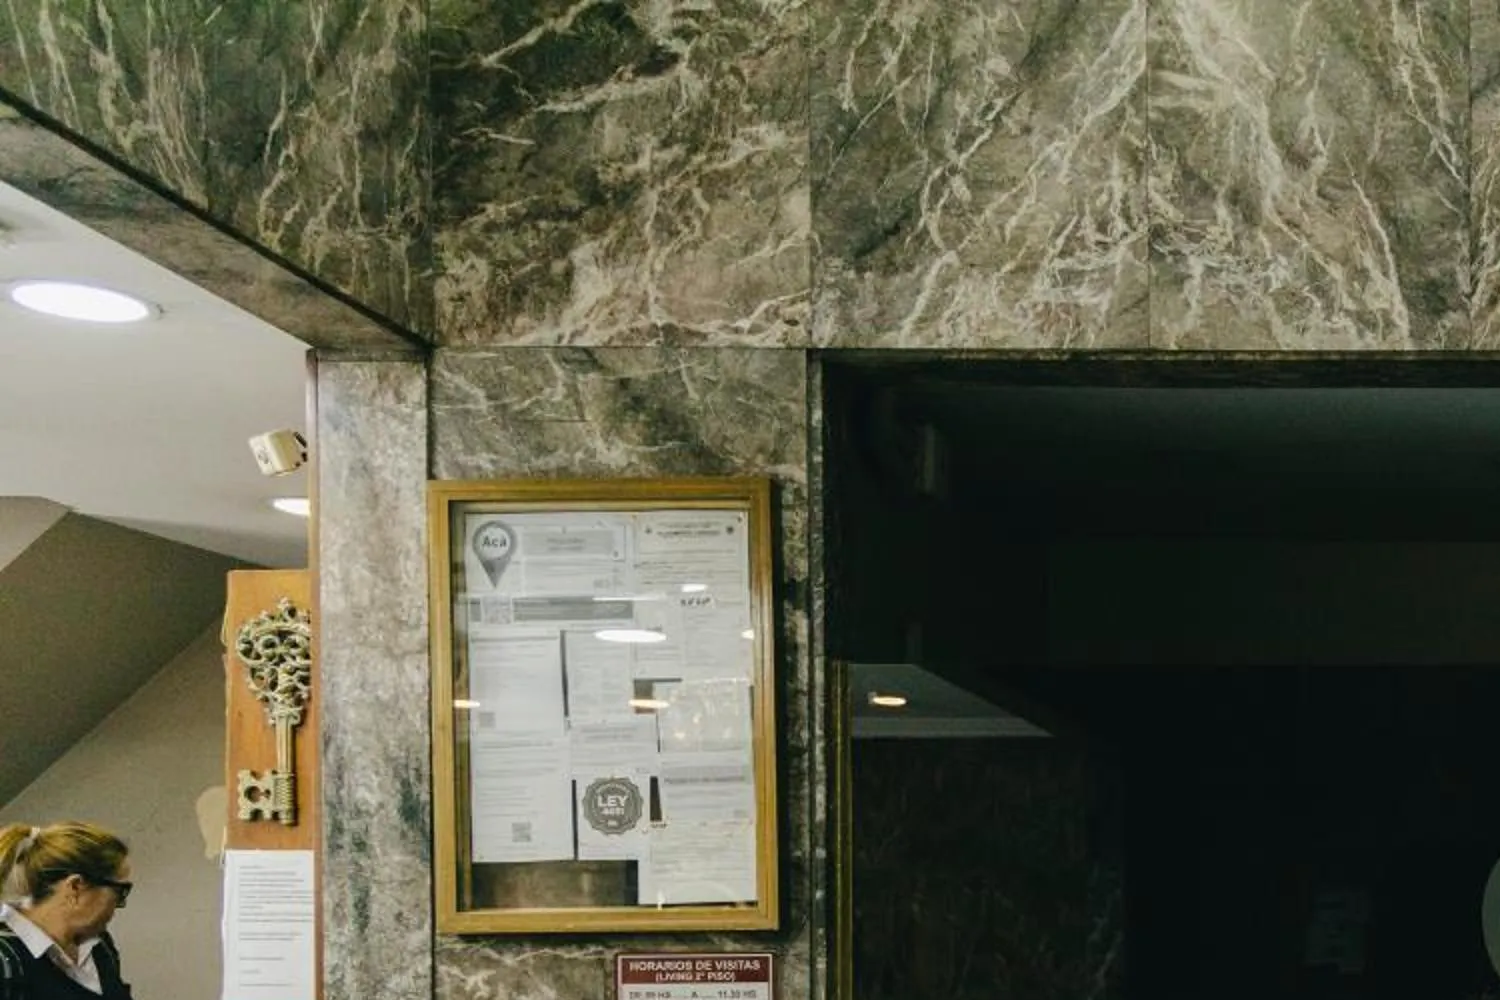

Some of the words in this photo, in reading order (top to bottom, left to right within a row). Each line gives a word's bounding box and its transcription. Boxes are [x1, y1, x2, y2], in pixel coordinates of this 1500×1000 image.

[597, 795, 628, 807] LEY
[629, 960, 692, 972] HORARIOS
[695, 960, 713, 971] DE
[715, 959, 761, 971] VISITAS
[655, 971, 692, 982] (LIVING
[707, 971, 736, 982] PISO)
[629, 991, 643, 999] DE
[691, 991, 699, 999] A
[743, 990, 757, 999] HS
